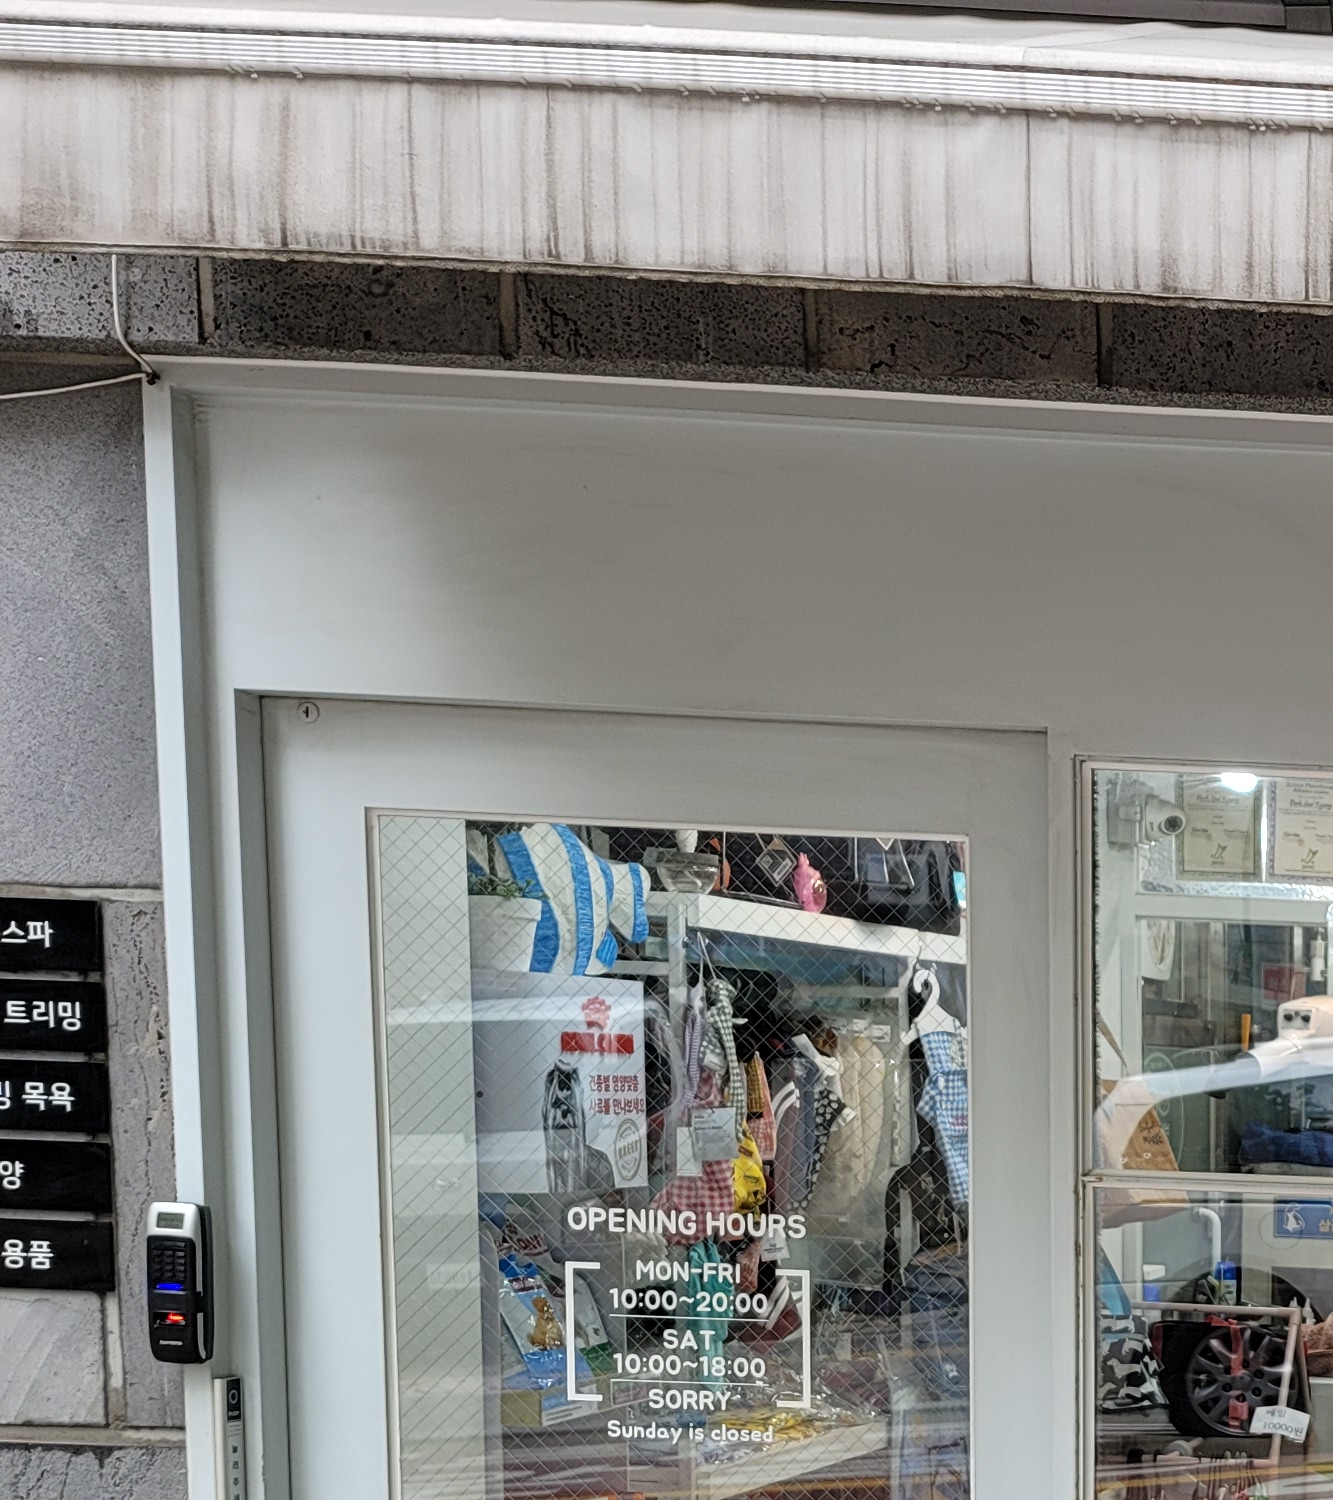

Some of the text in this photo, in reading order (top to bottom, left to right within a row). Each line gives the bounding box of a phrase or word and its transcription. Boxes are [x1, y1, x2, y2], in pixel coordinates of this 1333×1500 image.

[1, 920, 54, 948] 스파
[3, 1000, 82, 1031] 트리밍
[21, 1081, 75, 1112] 목욕
[567, 1206, 807, 1239] OPENING HOURS
[1, 1239, 54, 1269] 용품
[635, 1259, 741, 1284] MON-FRI
[608, 1287, 769, 1314] 10:00~20:00
[662, 1328, 716, 1351] SAT
[613, 1352, 767, 1378] 10:00~18:00
[648, 1388, 732, 1411] SORRY
[607, 1419, 775, 1445] Sunday is closed
